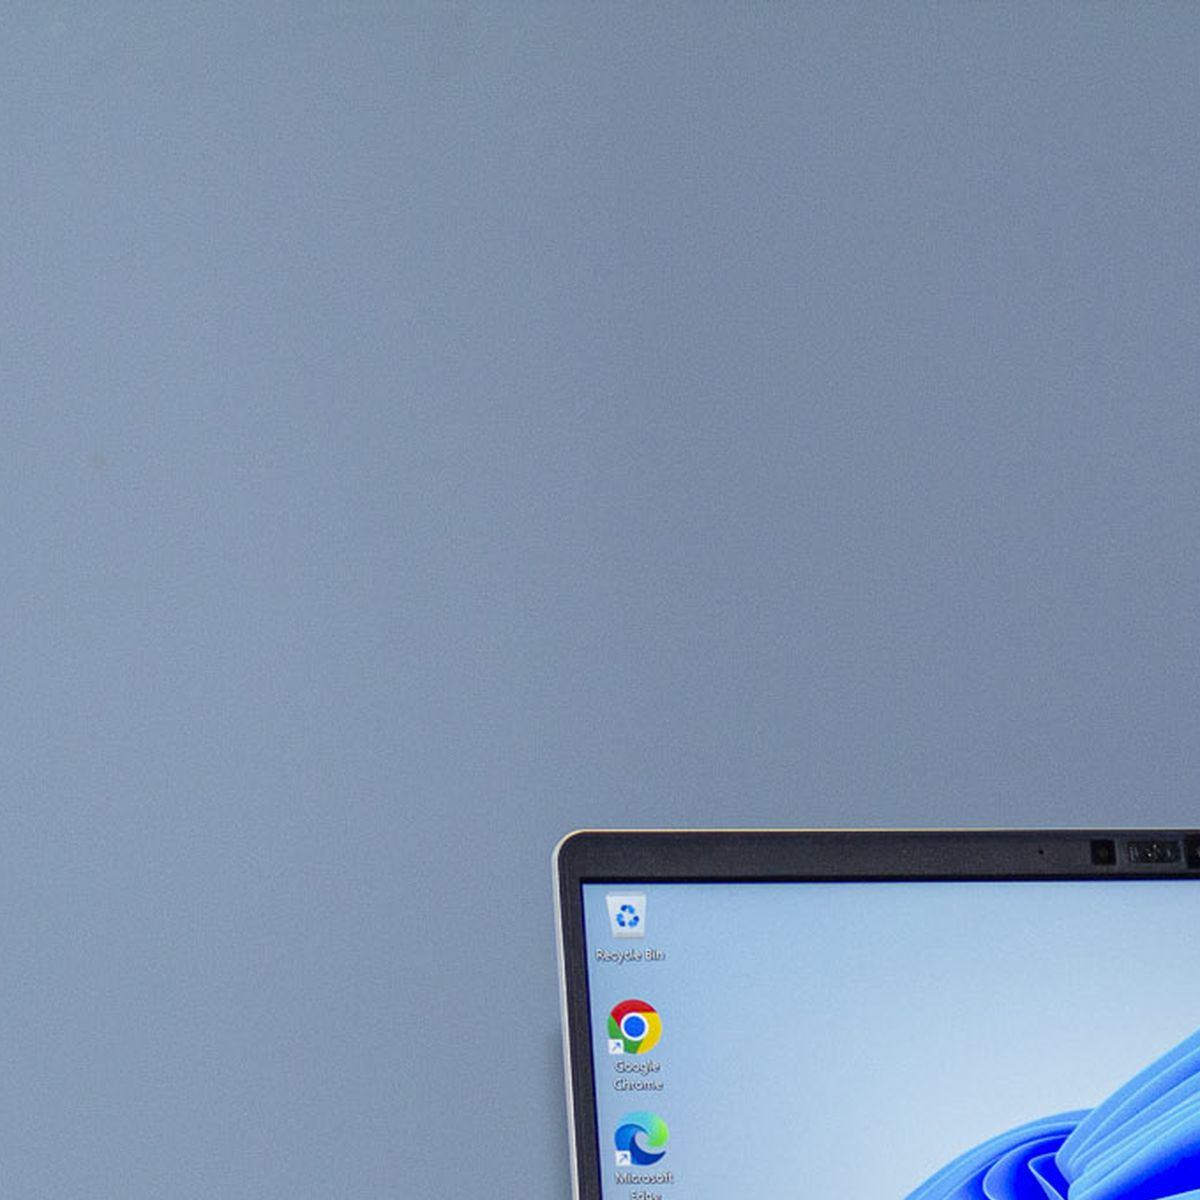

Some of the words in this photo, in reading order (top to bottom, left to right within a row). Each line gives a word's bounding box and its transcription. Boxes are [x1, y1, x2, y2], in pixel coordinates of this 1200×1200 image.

[596, 949, 641, 964] Recycle
[645, 949, 665, 960] Bin
[615, 1060, 660, 1076] Google
[613, 1079, 664, 1091] Chrome
[615, 1172, 674, 1184] Microsoft
